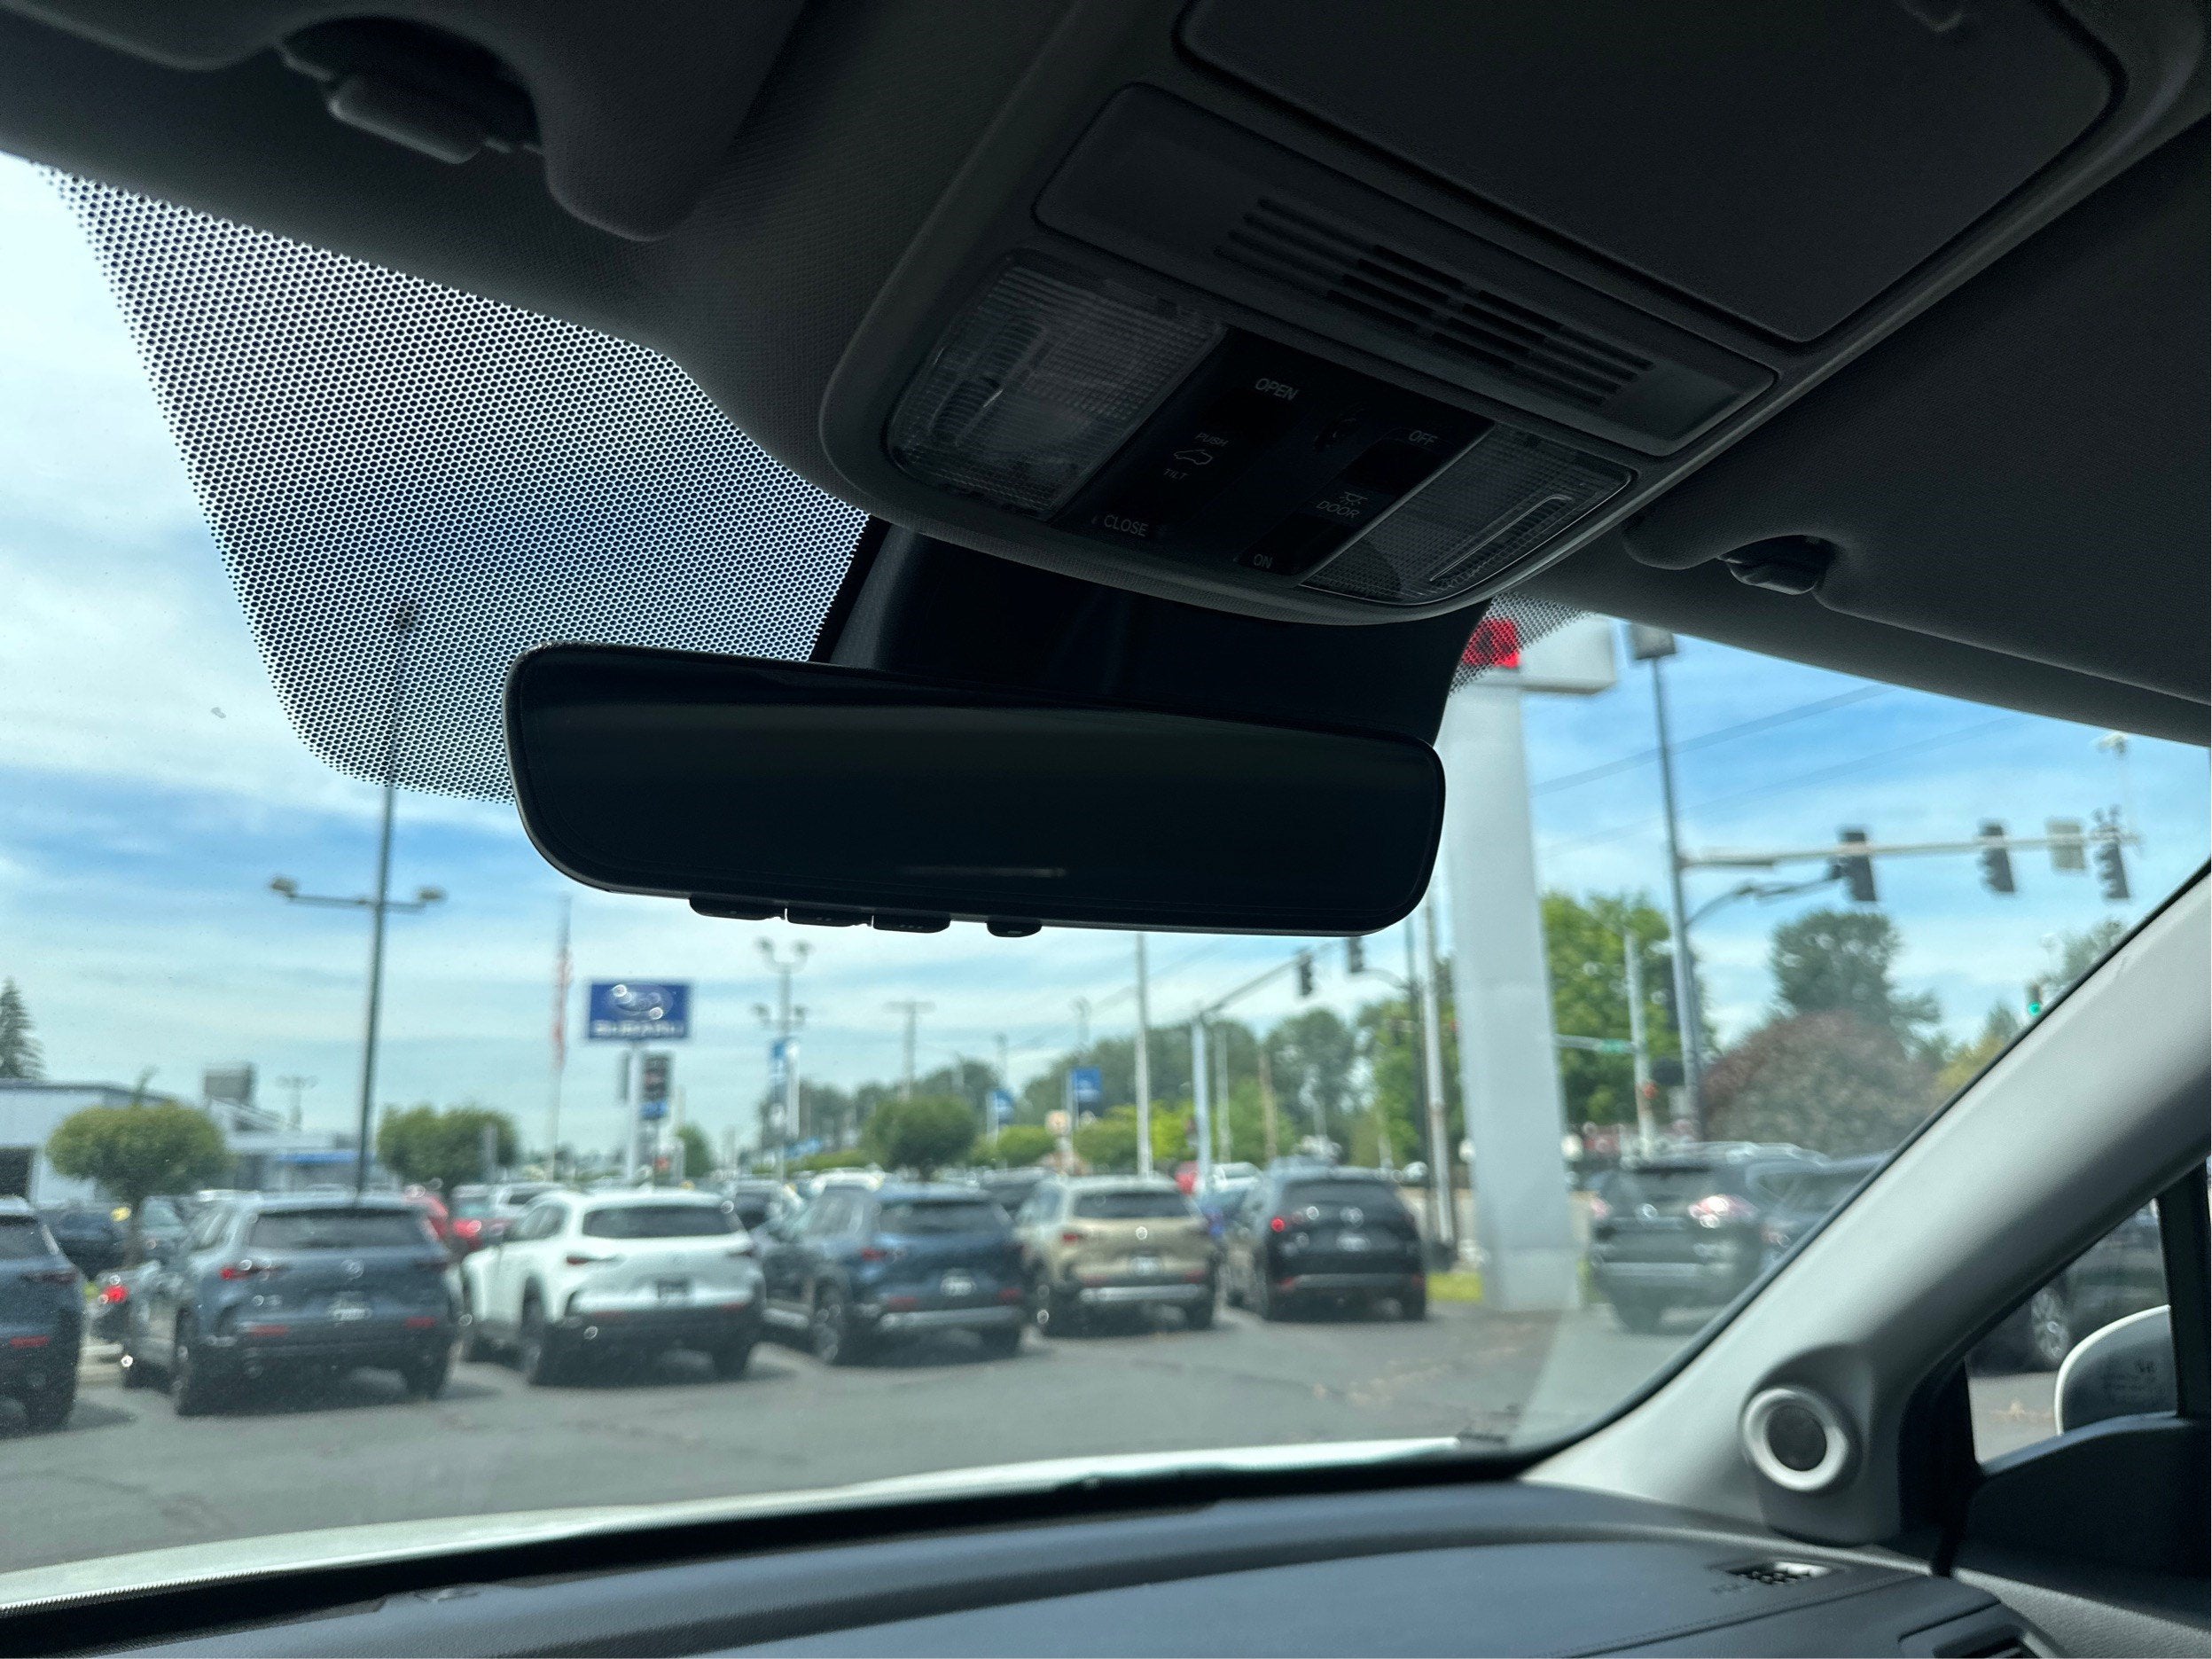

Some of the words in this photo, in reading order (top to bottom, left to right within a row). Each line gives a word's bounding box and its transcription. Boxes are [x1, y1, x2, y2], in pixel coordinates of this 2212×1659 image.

[1254, 377, 1300, 403] OPEN
[1194, 432, 1230, 448] PUSH
[1408, 430, 1437, 446] OFF
[1163, 467, 1189, 482] TILT
[1316, 499, 1360, 519] DOOR
[1103, 513, 1149, 538] CLOSE
[1253, 553, 1273, 570] ON
